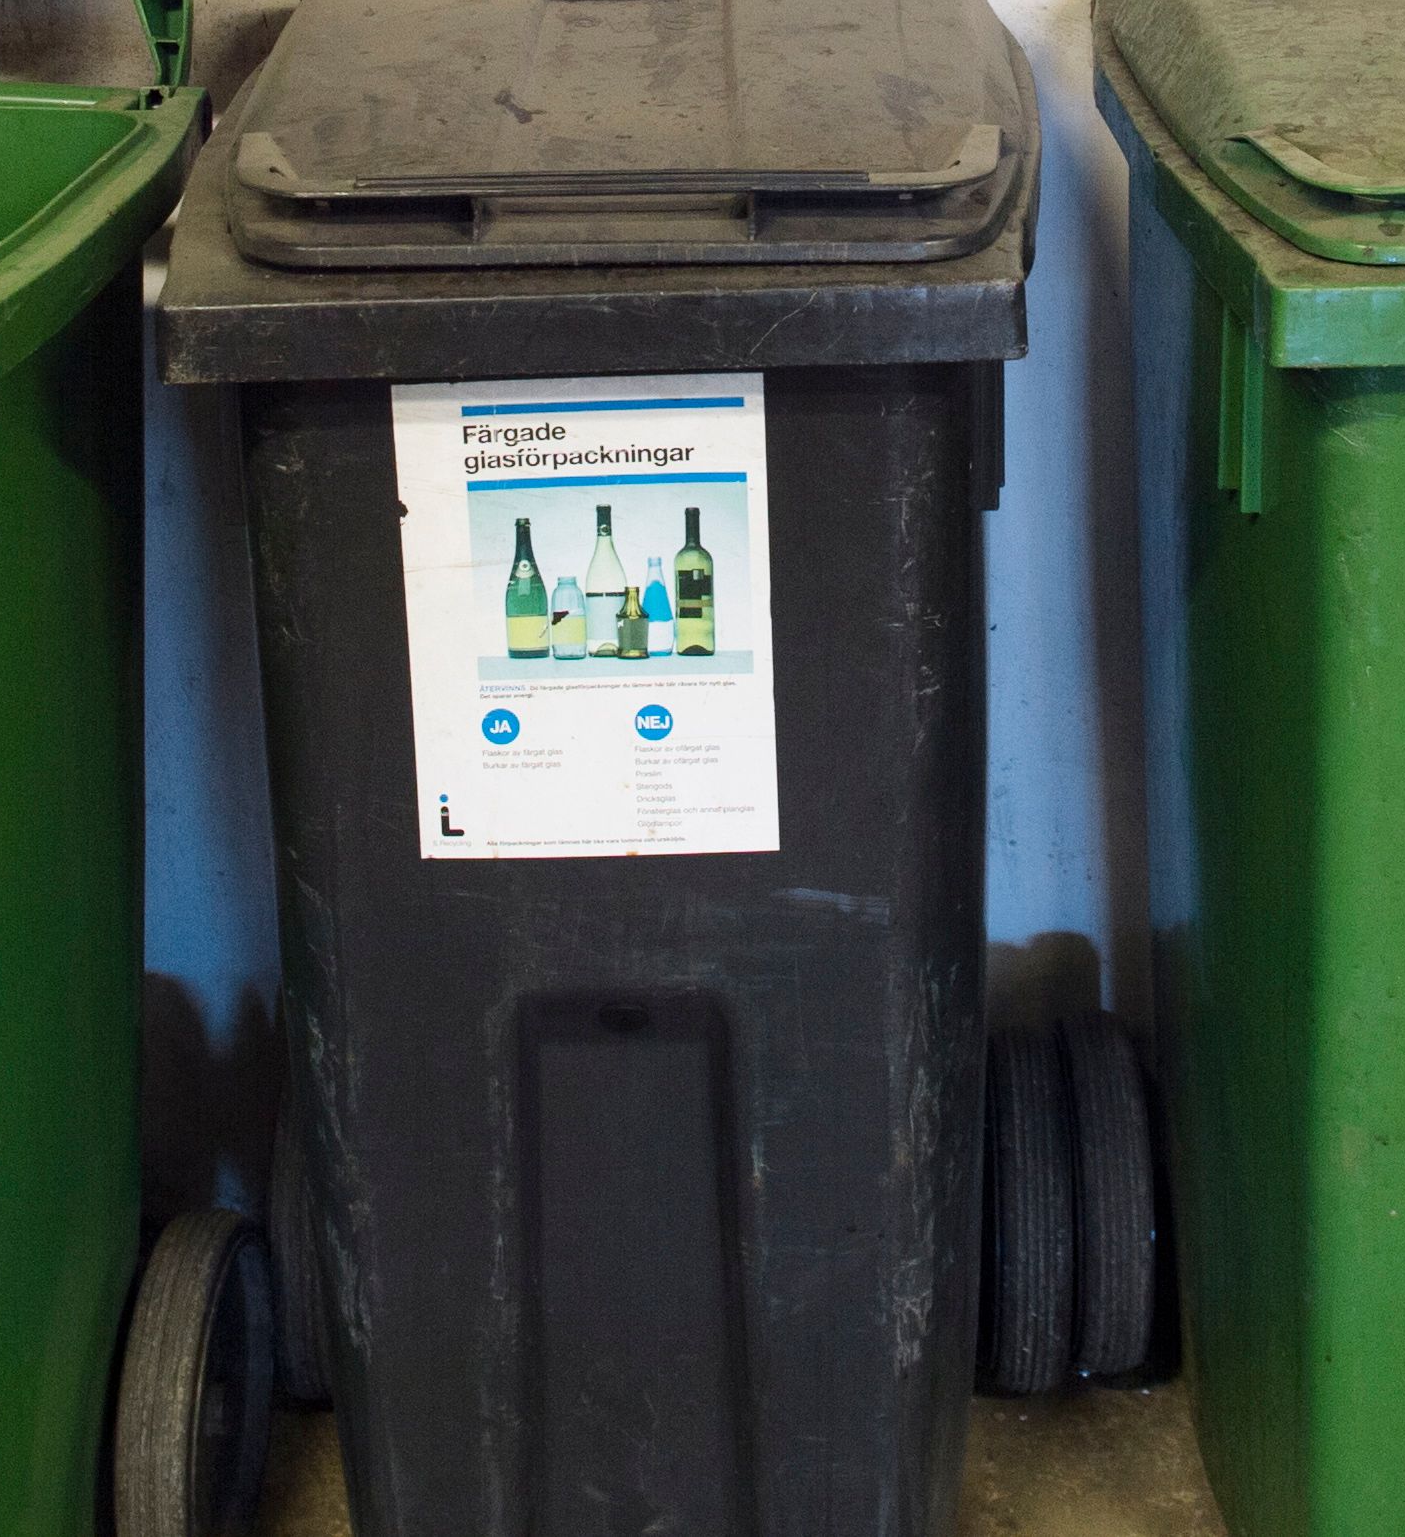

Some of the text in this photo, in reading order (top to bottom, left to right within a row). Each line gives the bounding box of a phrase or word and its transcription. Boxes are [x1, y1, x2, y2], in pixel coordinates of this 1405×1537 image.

[462, 422, 566, 446] Färgade
[489, 719, 512, 734] JA
[636, 715, 670, 730] NEJ
